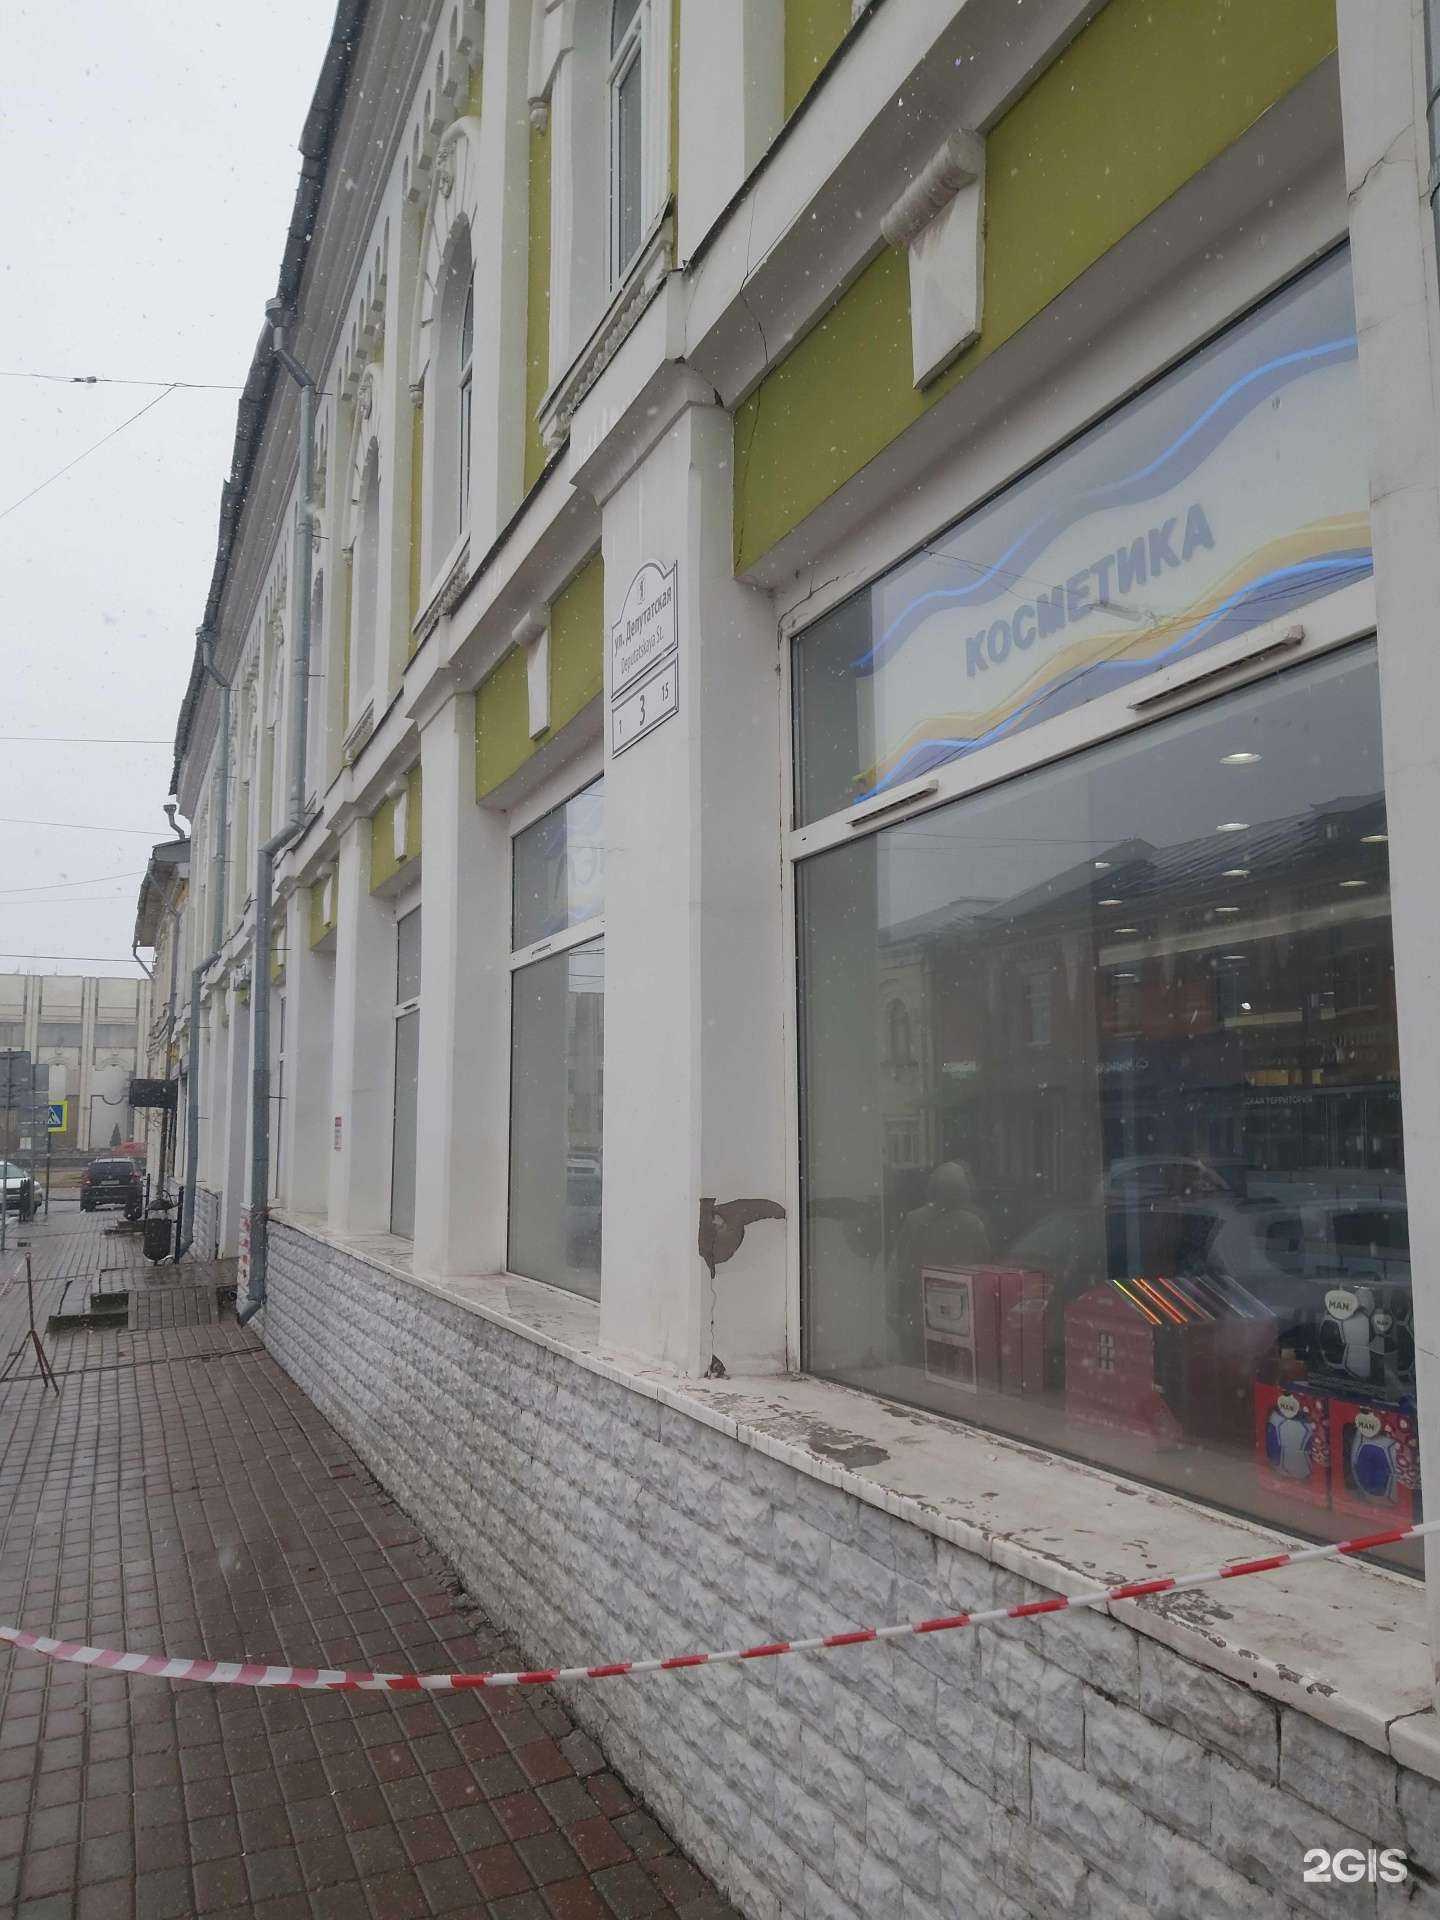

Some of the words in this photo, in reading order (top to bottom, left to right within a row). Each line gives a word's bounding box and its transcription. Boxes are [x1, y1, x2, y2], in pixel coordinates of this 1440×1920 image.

[966, 503, 1215, 678] КОСМЕТИКА
[614, 634, 625, 657] ул.
[626, 586, 672, 642] Депутатская
[639, 694, 646, 727] 3
[662, 681, 669, 702] 15
[1328, 1300, 1350, 1312] MAN
